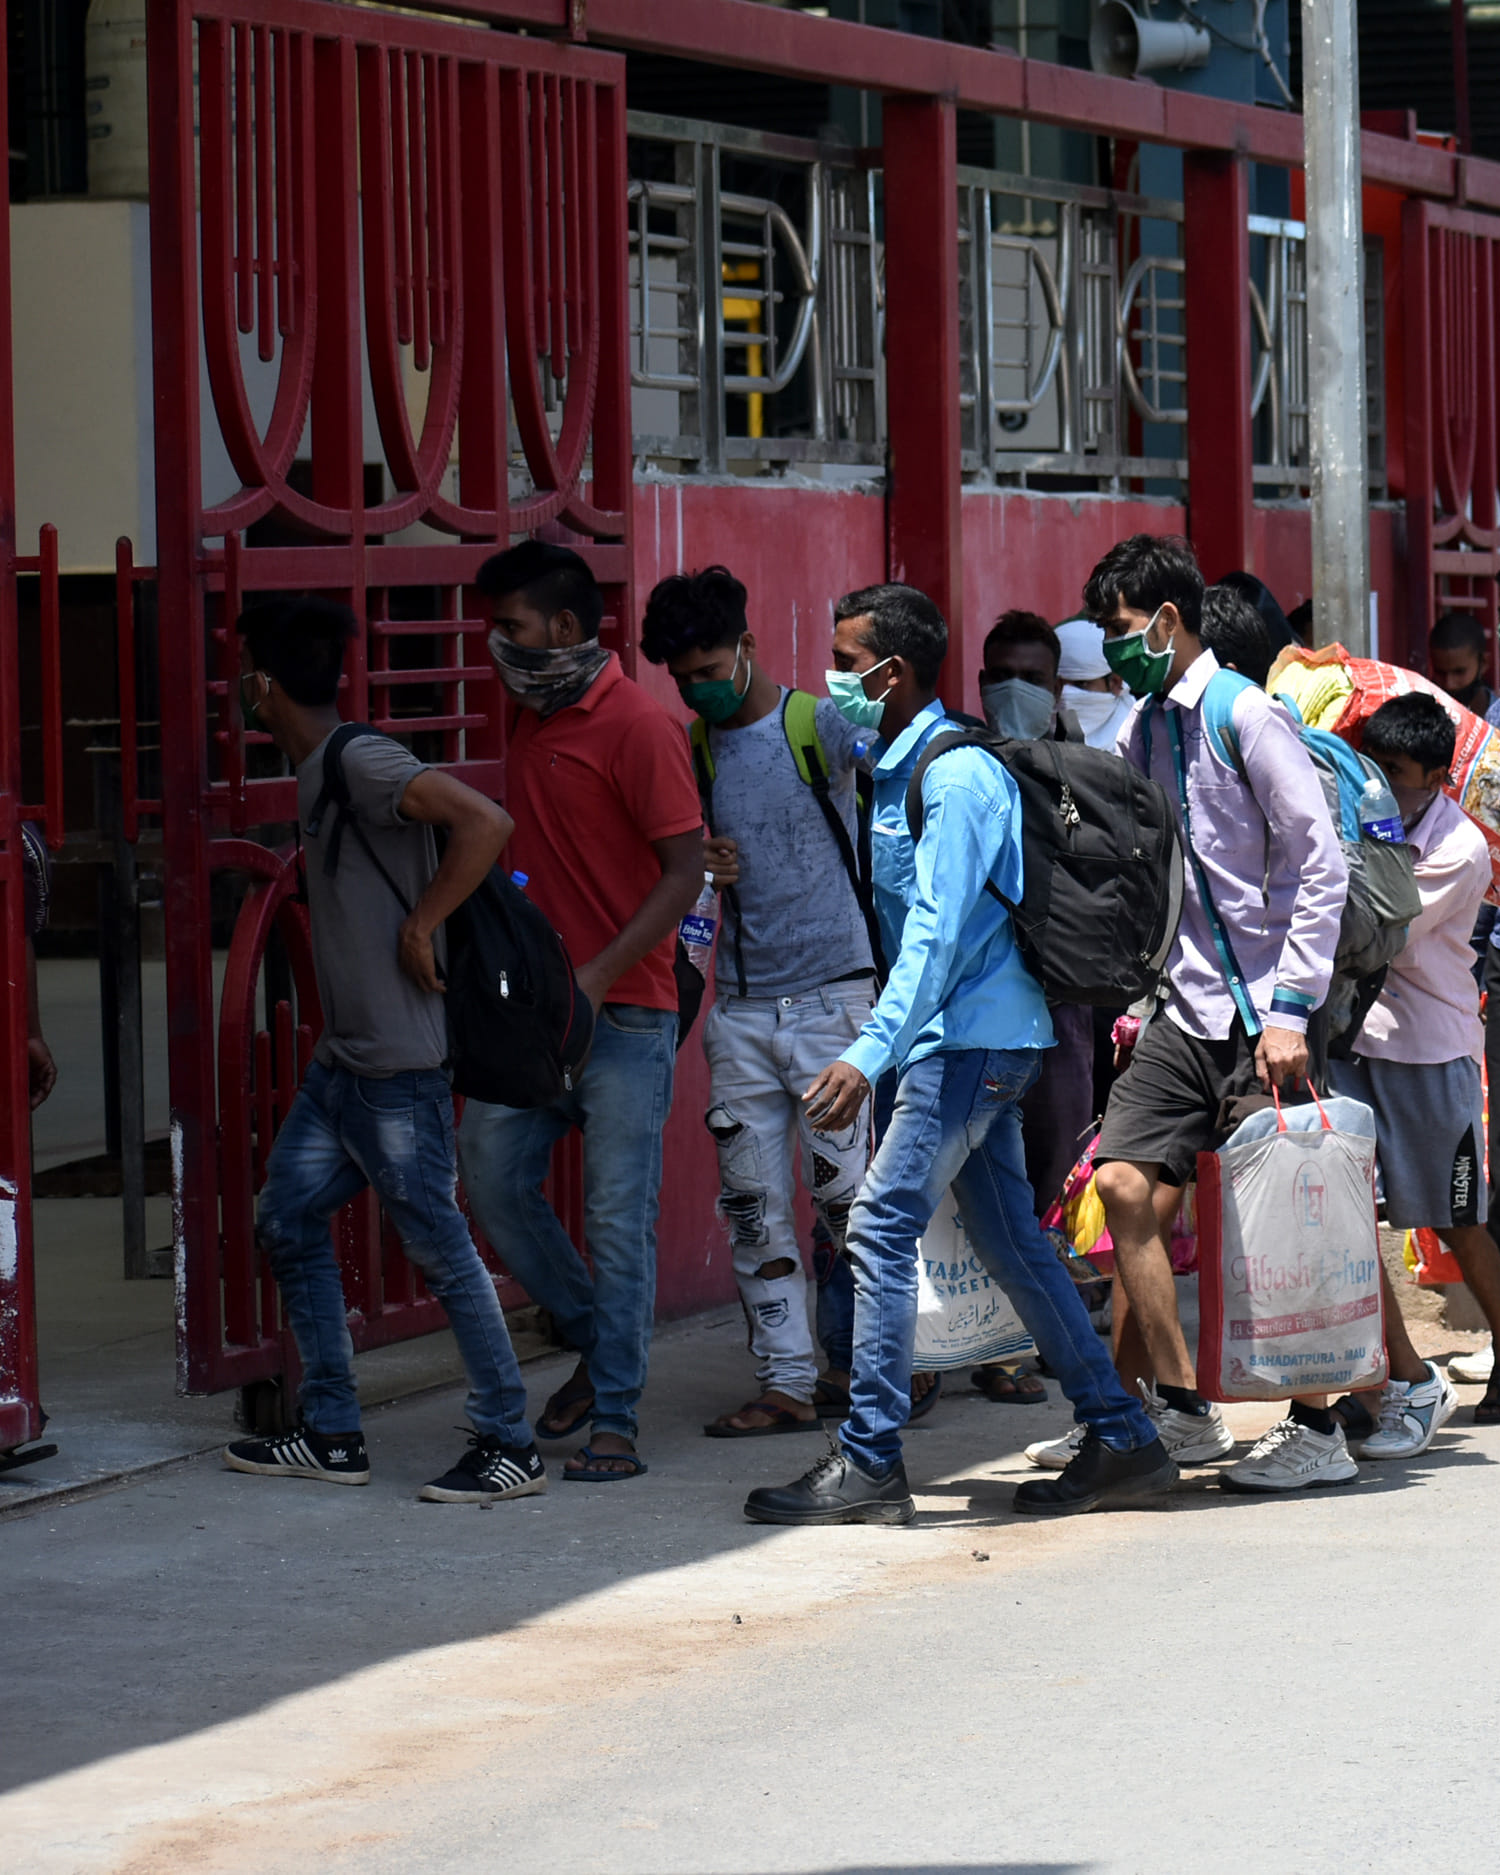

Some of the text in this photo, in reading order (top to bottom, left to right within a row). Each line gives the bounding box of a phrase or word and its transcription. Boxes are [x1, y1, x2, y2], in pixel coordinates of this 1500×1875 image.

[1453, 1155, 1473, 1209] MONSTER
[1248, 1351, 1336, 1367] SAHADATPURA
[1344, 1347, 1366, 1361] MAU
